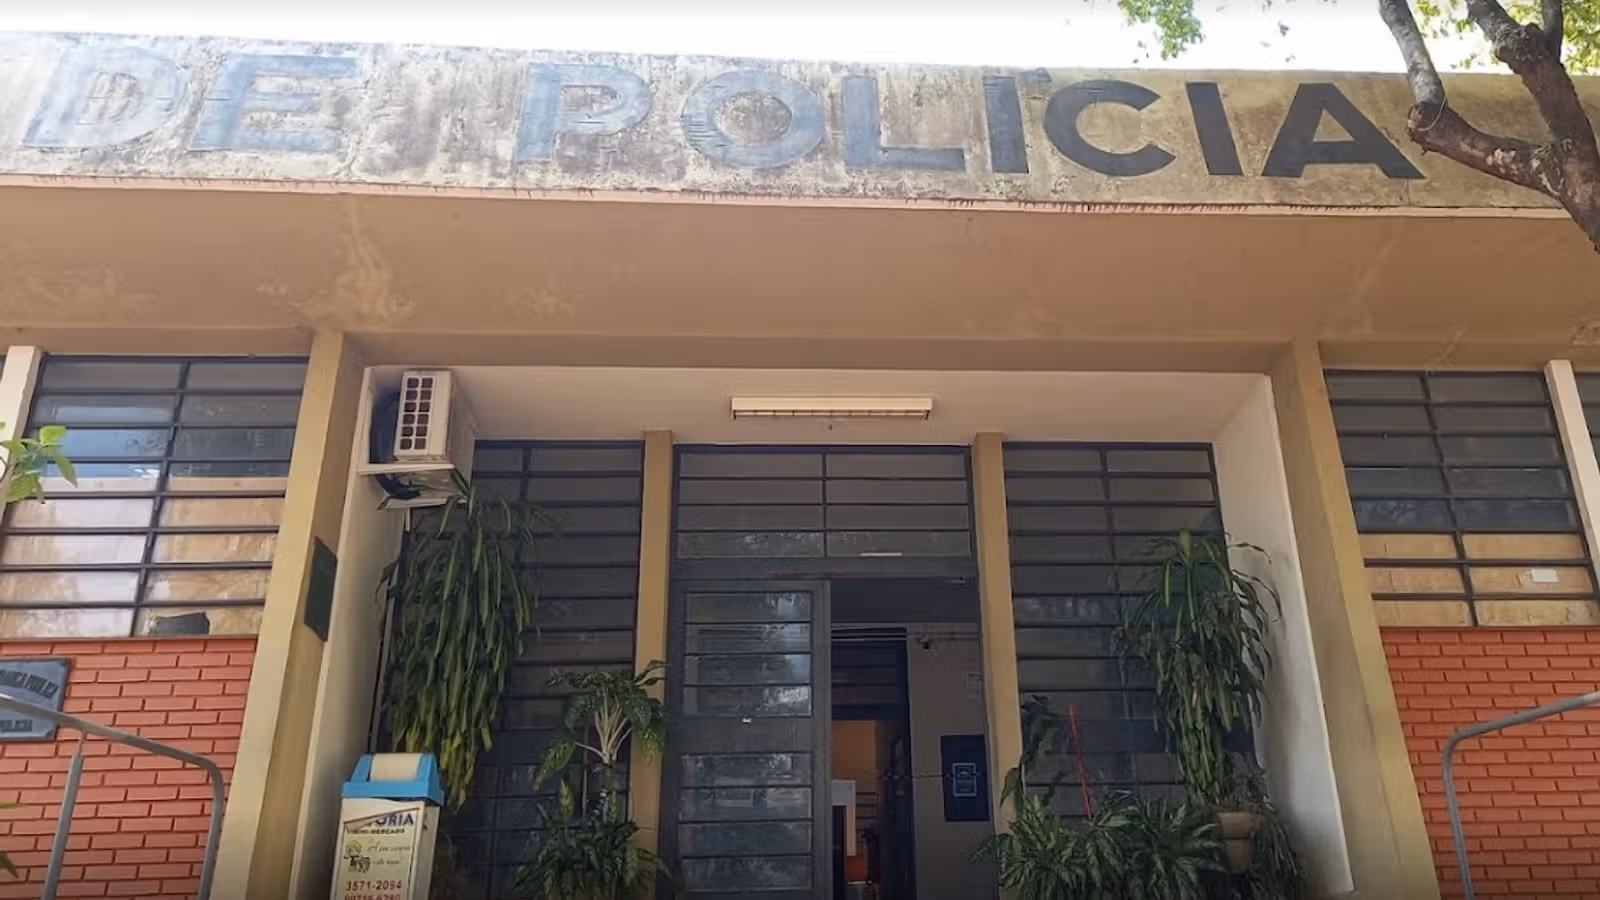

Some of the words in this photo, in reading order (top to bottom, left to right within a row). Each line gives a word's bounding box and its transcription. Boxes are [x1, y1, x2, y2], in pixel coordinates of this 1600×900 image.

[23, 46, 358, 152] DE
[513, 63, 1426, 180] POLÍCIA
[346, 880, 402, 891] 3571-2094
